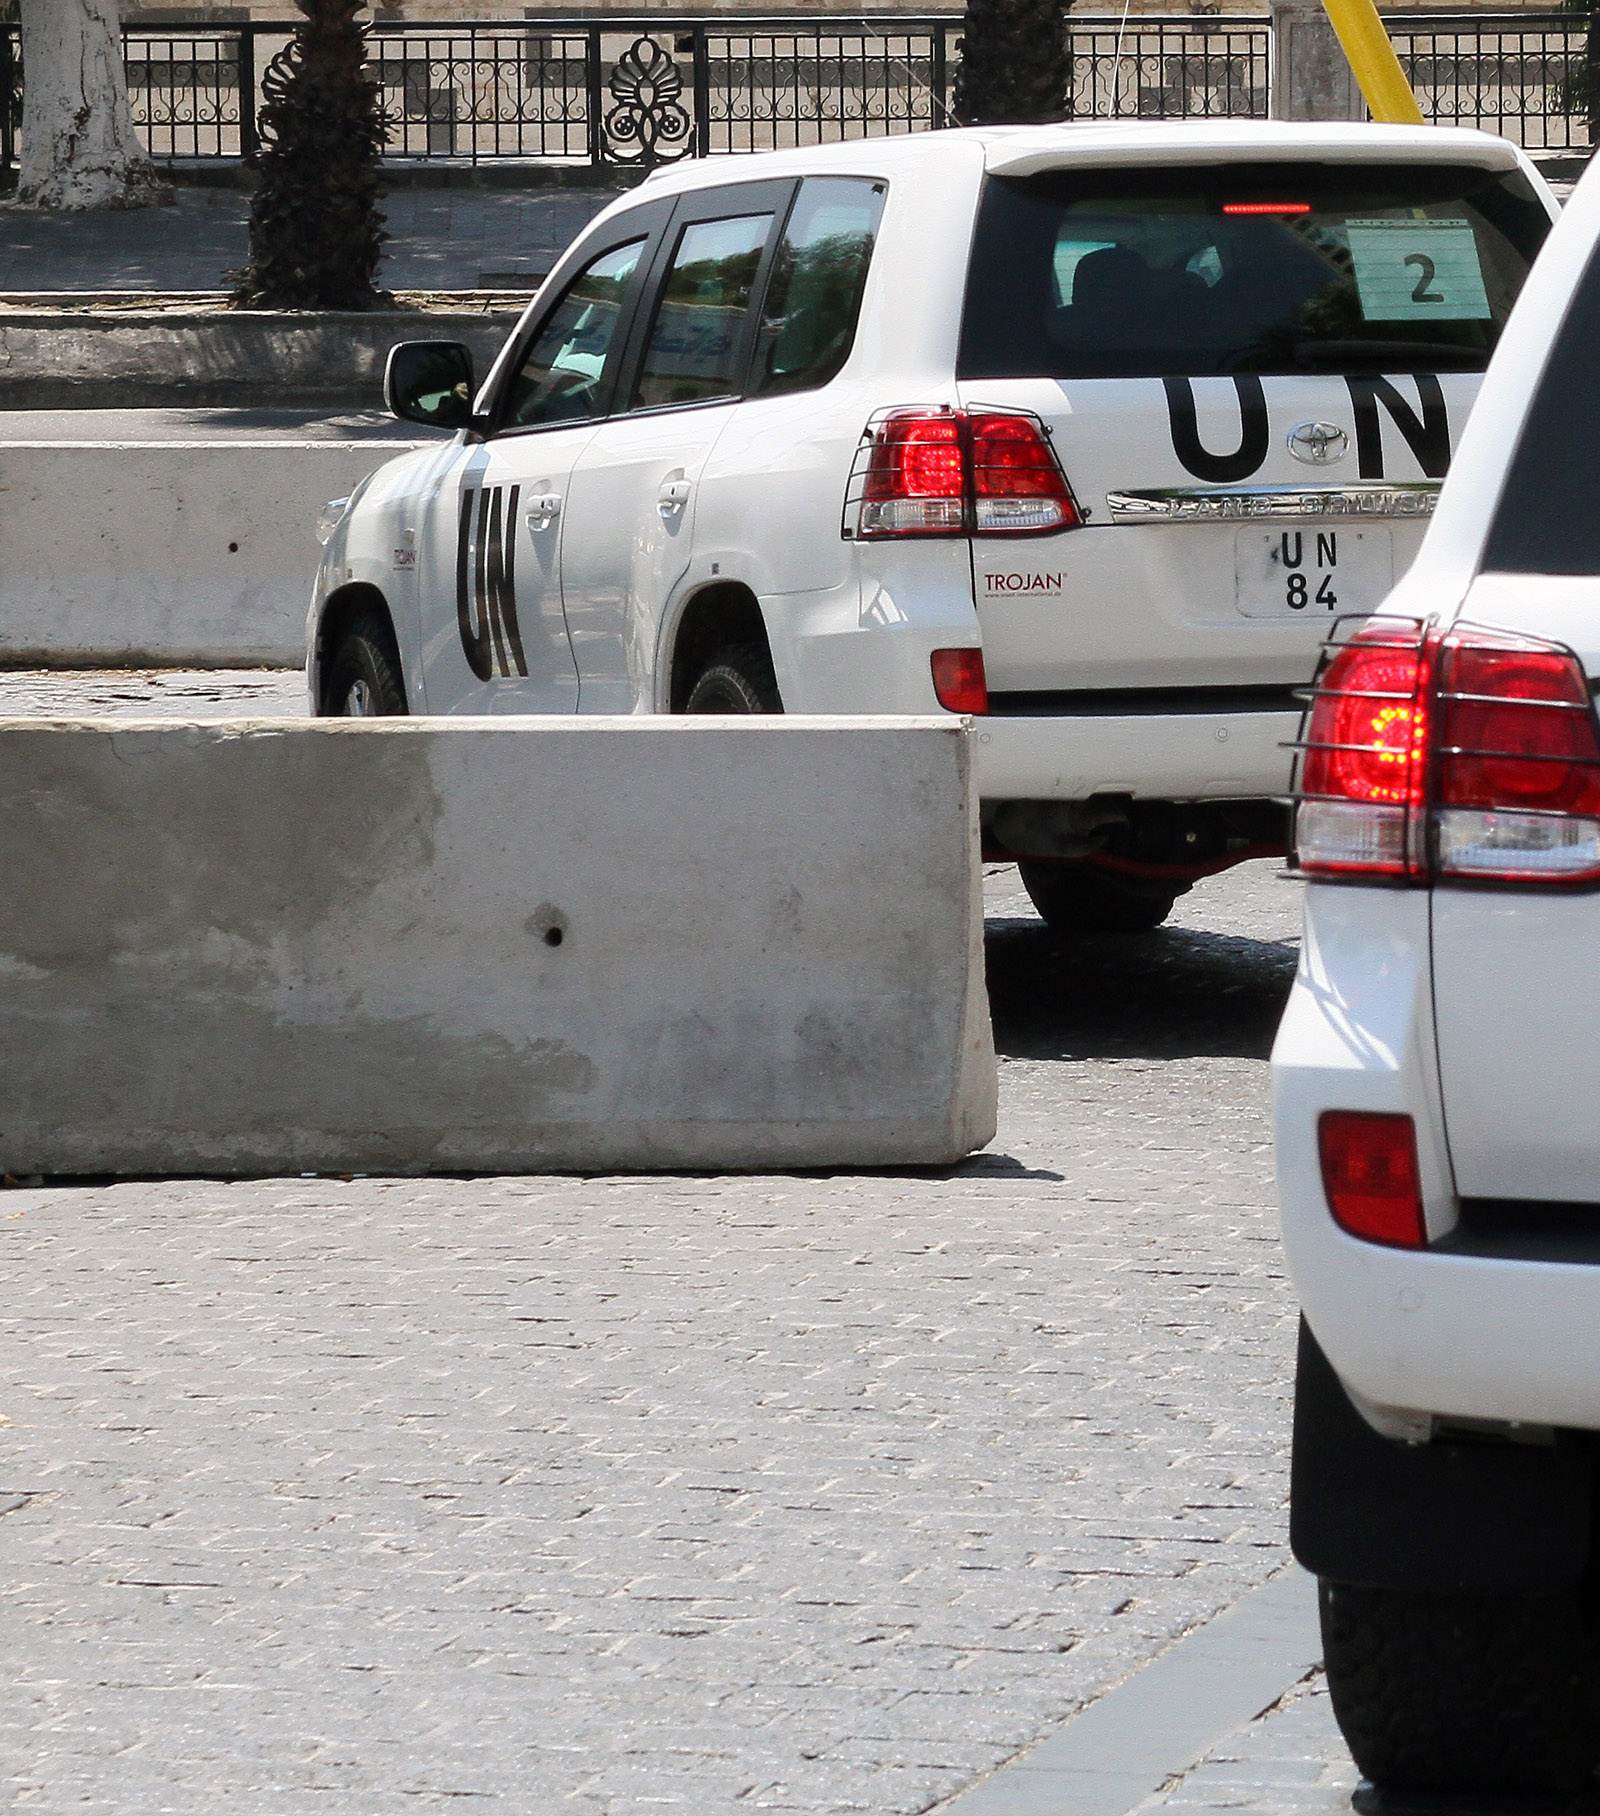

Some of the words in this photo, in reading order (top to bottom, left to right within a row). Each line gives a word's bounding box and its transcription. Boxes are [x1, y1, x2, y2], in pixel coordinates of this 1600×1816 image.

[1404, 253, 1444, 302] 2
[1168, 495, 1273, 518] LAND
[1299, 493, 1440, 517] CRUISE
[456, 484, 529, 682] UN
[984, 573, 1062, 591] TROJAN
[1286, 573, 1338, 611] 84
